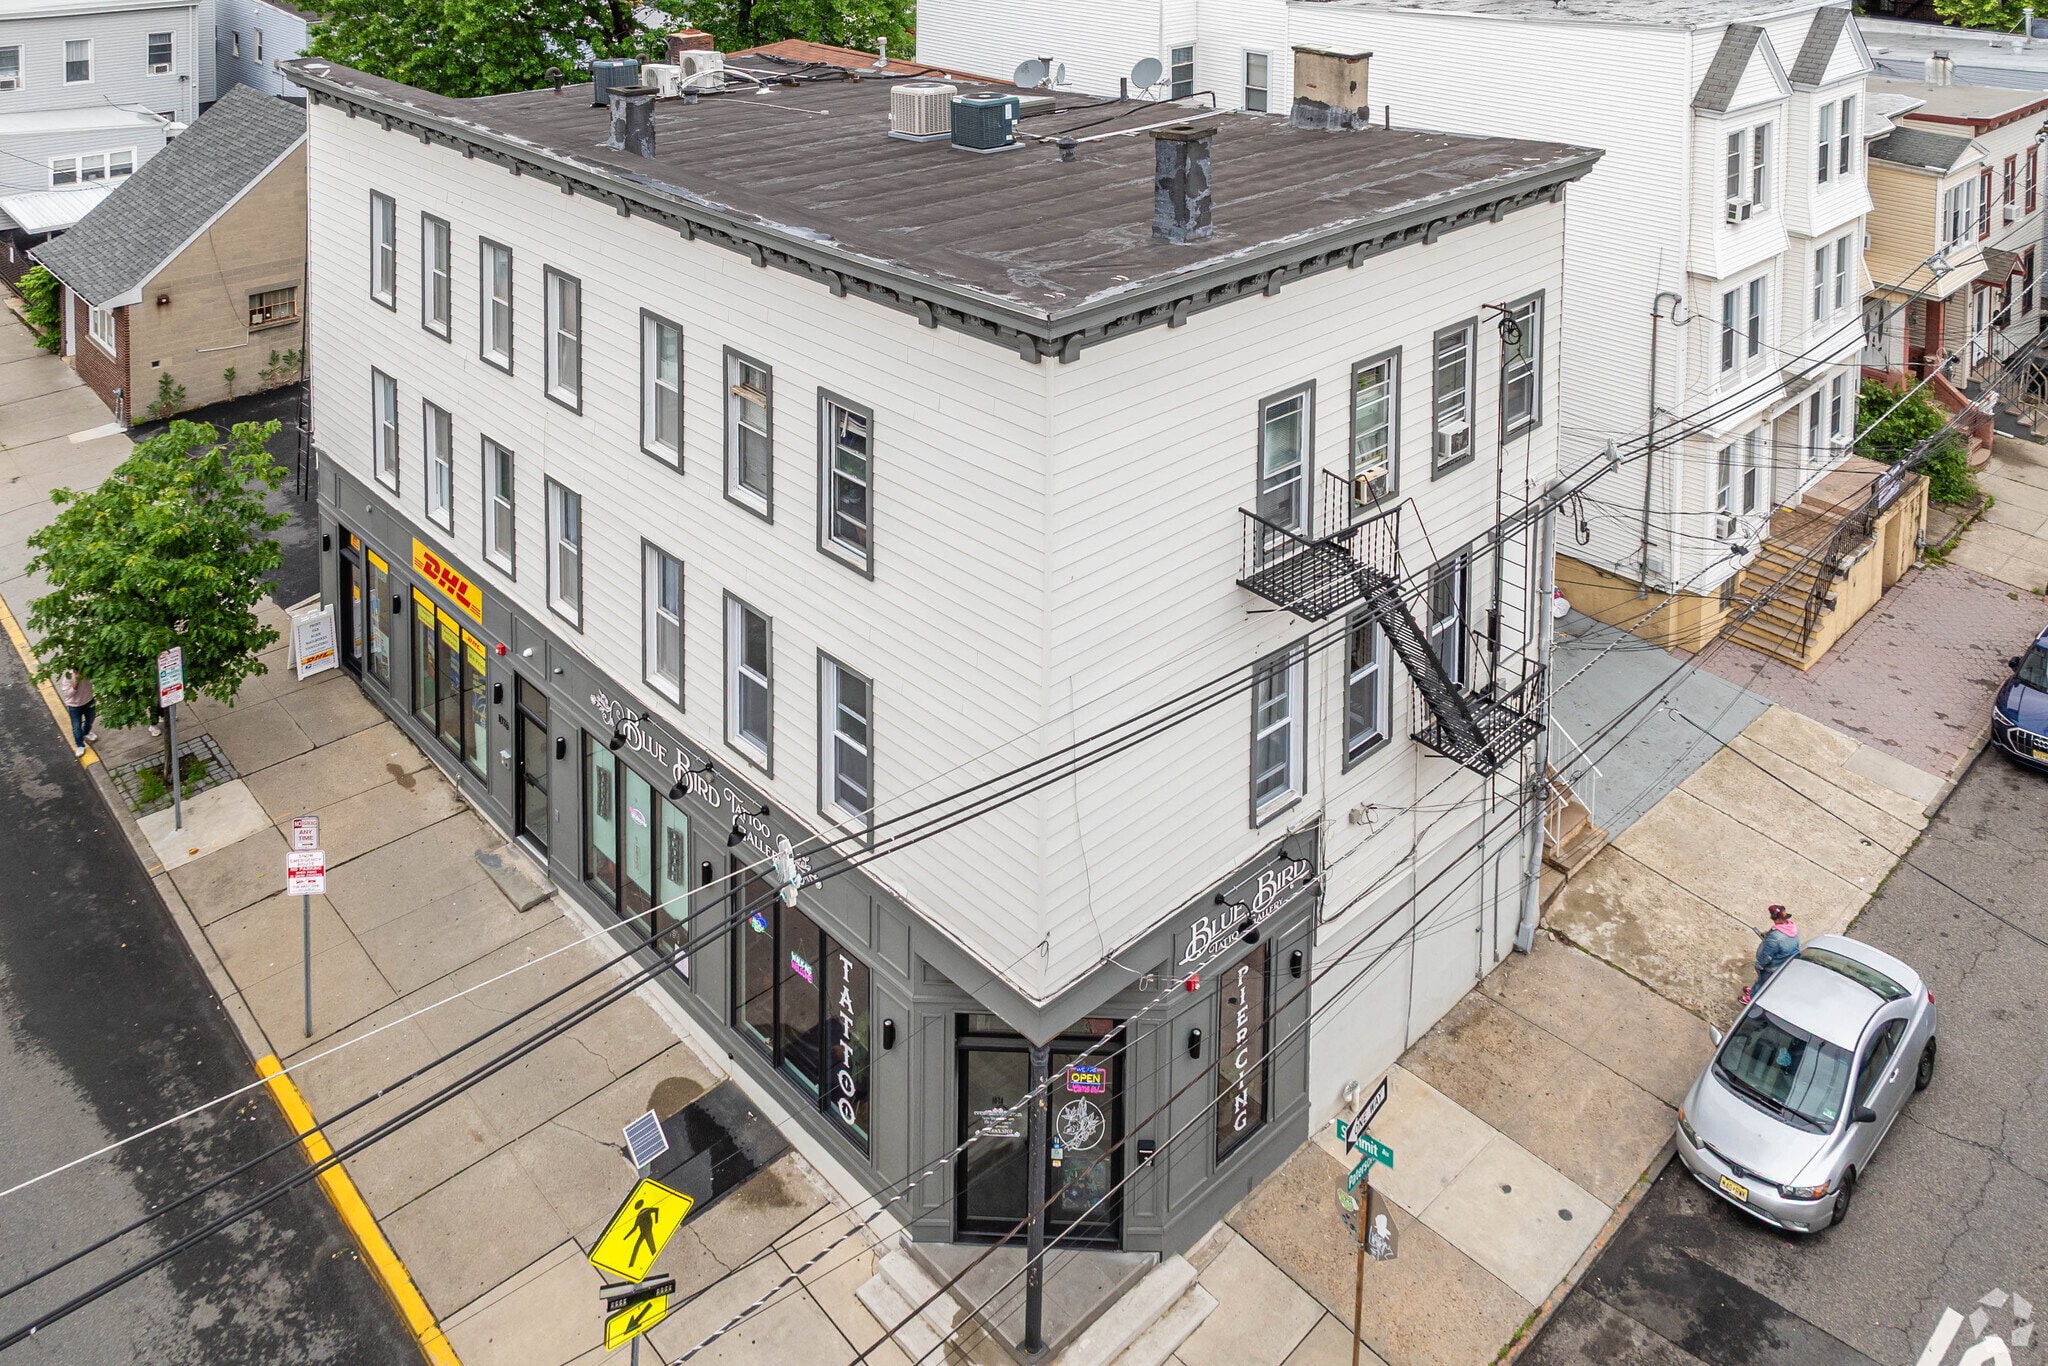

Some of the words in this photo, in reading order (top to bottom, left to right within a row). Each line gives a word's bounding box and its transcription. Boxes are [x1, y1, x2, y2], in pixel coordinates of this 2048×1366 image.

[423, 551, 472, 609] DHL
[306, 652, 329, 663] DHL
[466, 635, 481, 651] DHL
[838, 953, 856, 1126] TATTOO
[1233, 965, 1249, 1132] PIERCING
[1071, 1072, 1101, 1083] OPEN
[1353, 1112, 1368, 1136] ONE
[1369, 1089, 1385, 1115] WAY
